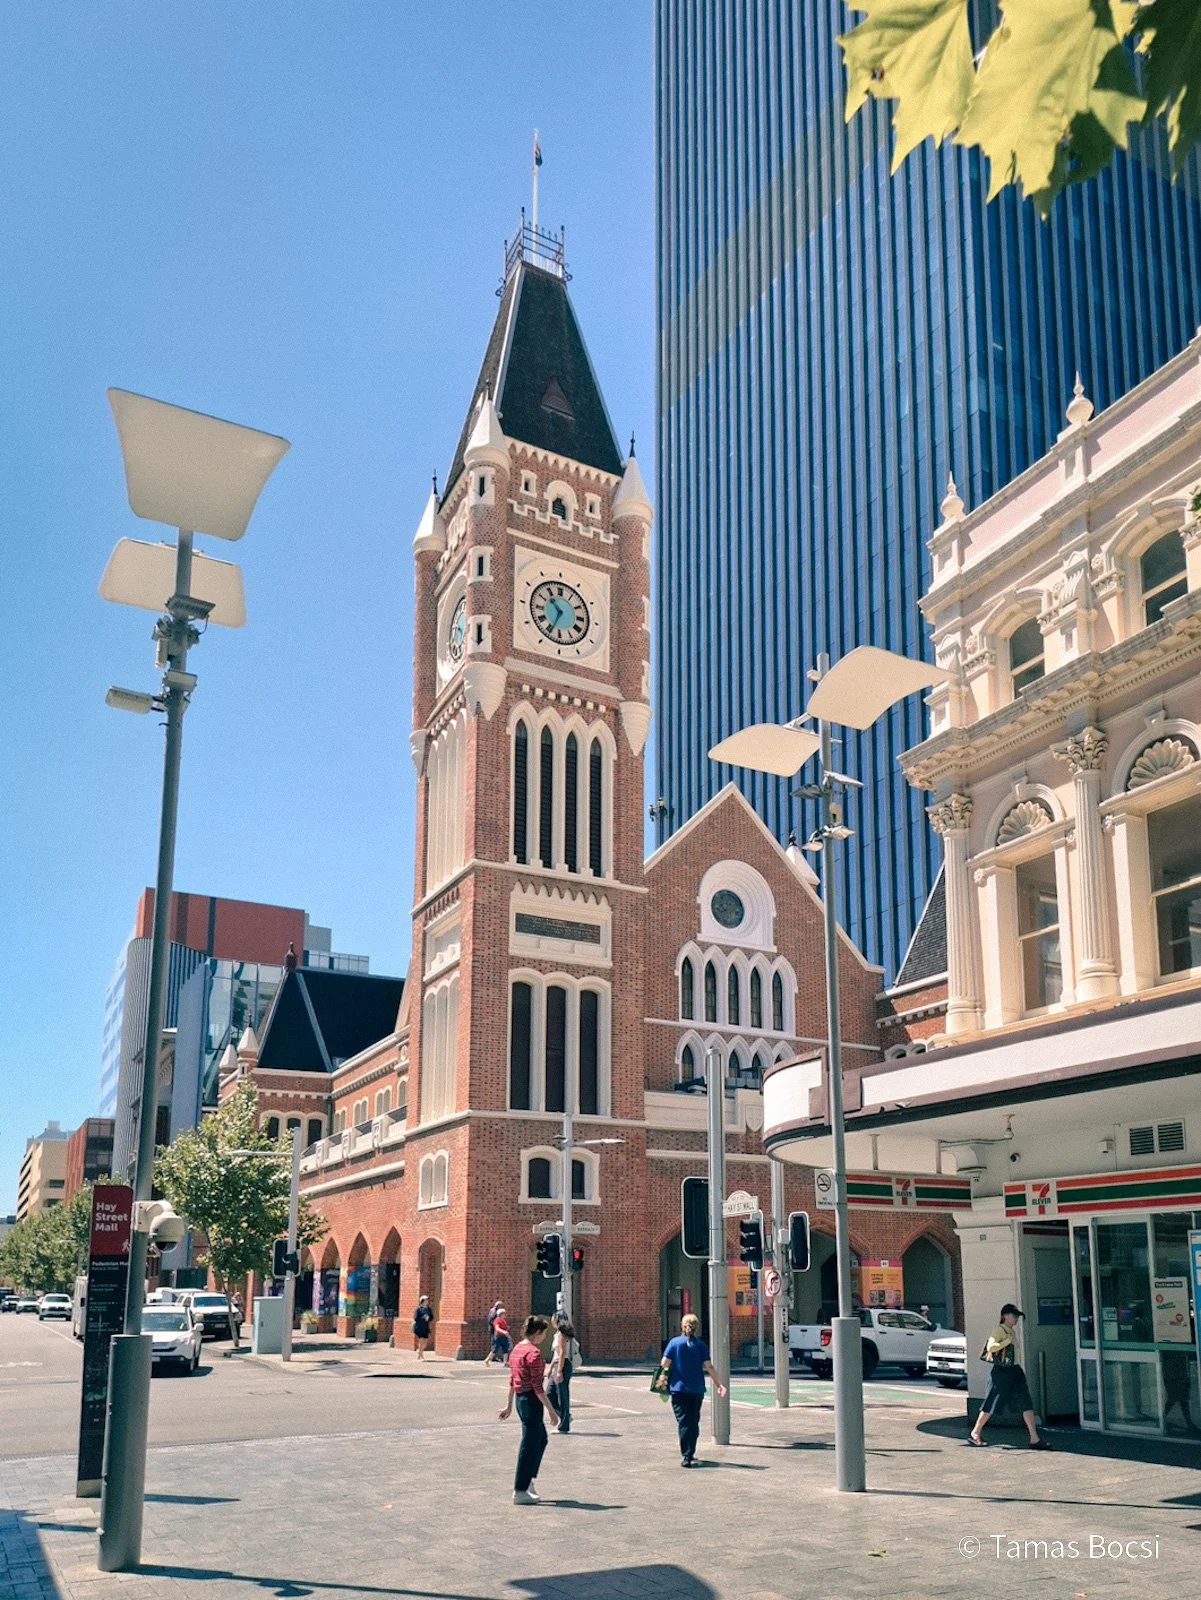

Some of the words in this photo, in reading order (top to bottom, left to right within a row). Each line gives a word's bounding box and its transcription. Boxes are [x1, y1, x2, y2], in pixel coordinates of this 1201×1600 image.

[1032, 1183, 1050, 1215] 7
[96, 1202, 117, 1213] Hay
[95, 1212, 128, 1221] Street
[95, 1222, 119, 1232] Mall
